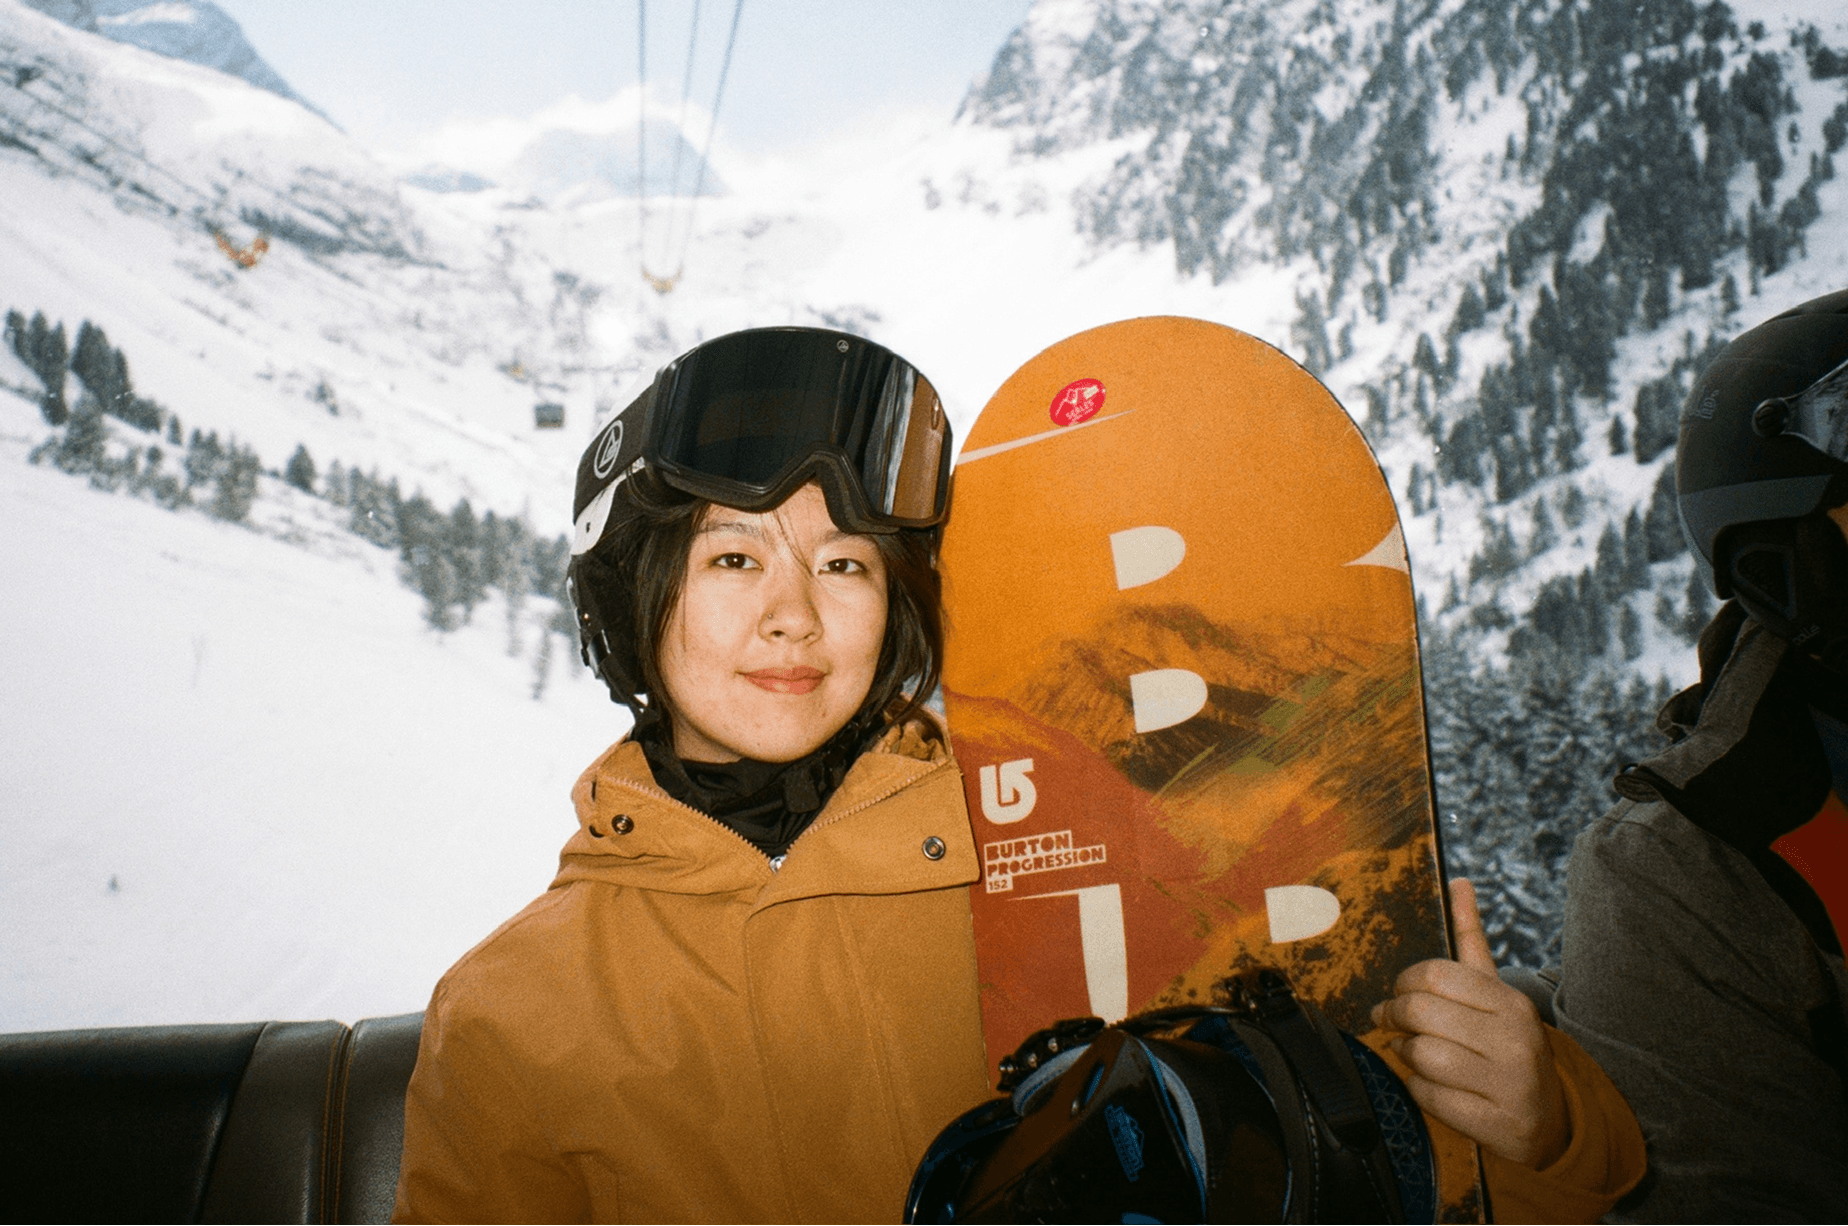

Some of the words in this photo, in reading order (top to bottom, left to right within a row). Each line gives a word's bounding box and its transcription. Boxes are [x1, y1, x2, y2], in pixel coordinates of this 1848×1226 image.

[986, 833, 1069, 861] BURTON
[987, 848, 1103, 876] PROGRESSION
[989, 879, 1008, 891] 152
